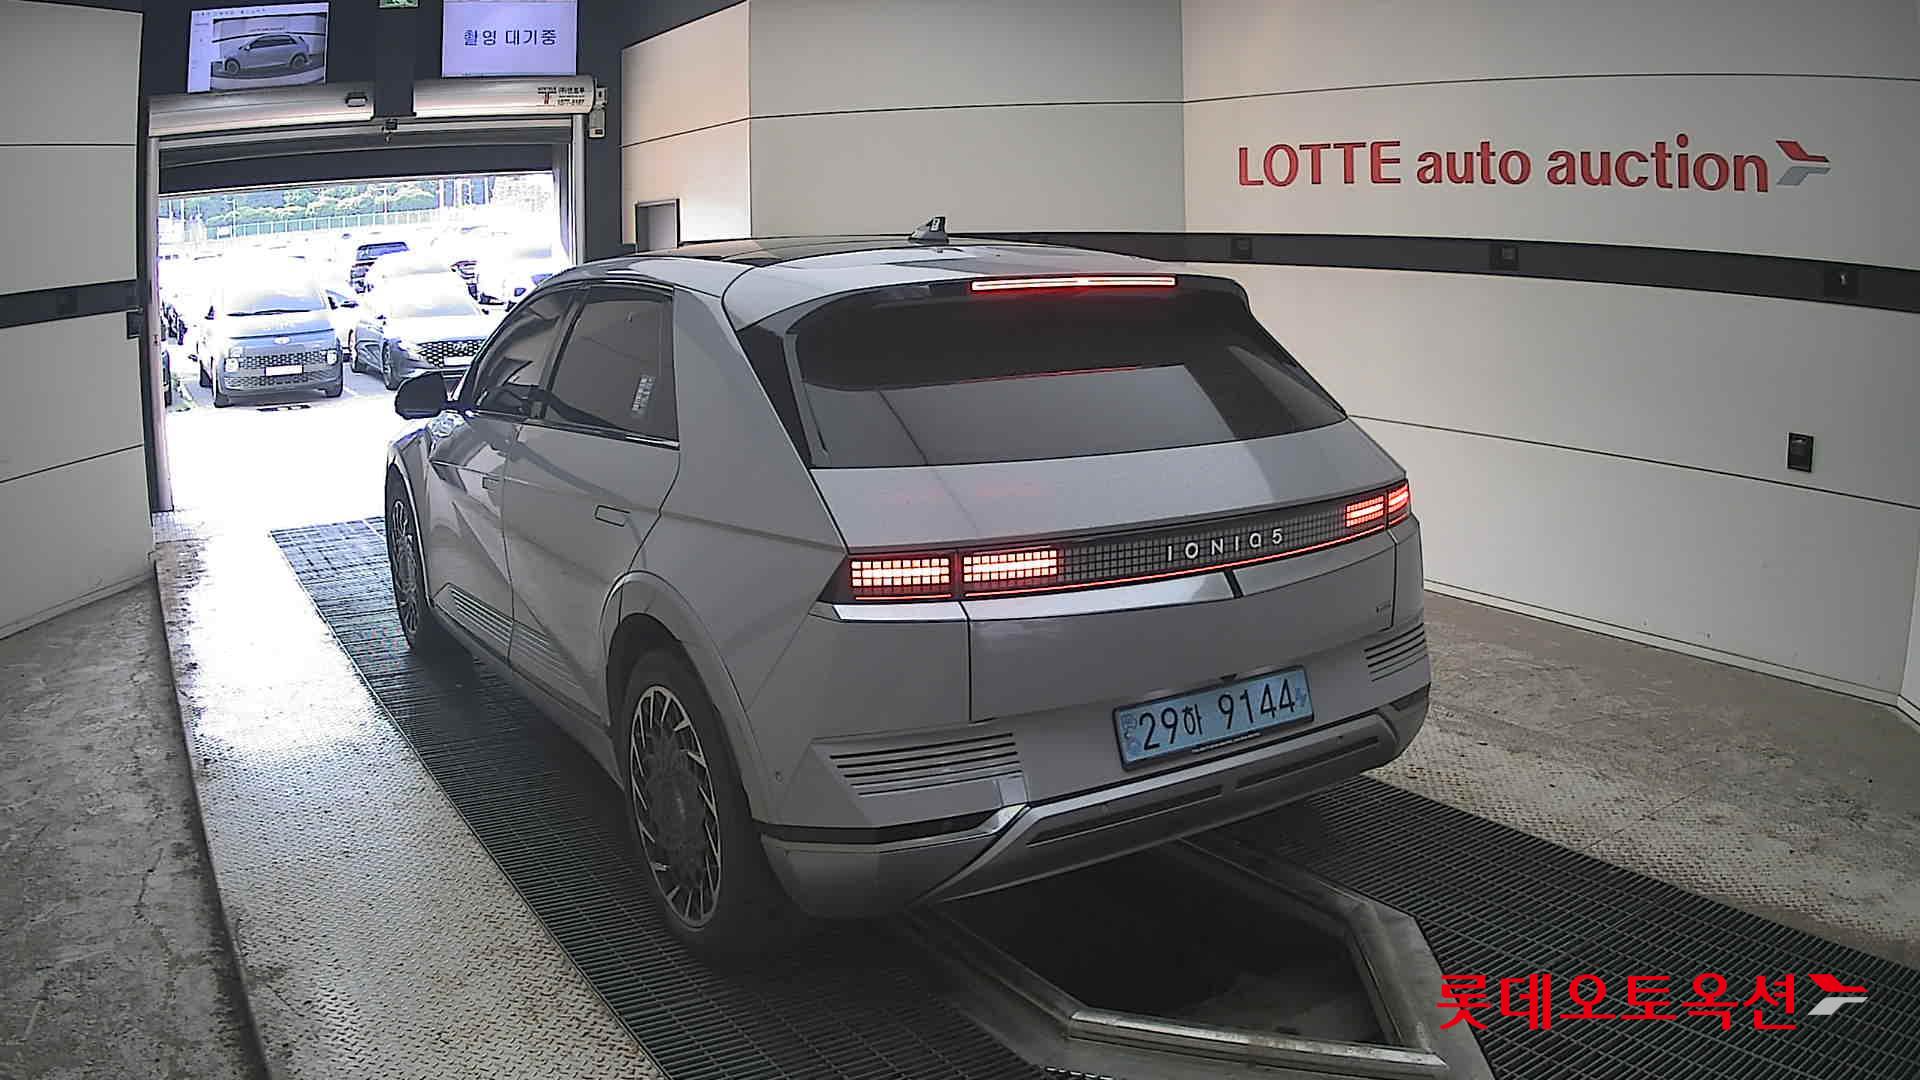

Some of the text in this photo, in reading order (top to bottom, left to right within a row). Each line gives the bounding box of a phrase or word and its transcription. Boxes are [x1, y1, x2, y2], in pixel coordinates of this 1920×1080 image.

[505, 29, 557, 46] 대기중
[1238, 133, 1769, 193] LOTTE auto auction
[1167, 527, 1284, 562] IONIQ 5
[1138, 678, 1296, 751] 29하 9144
